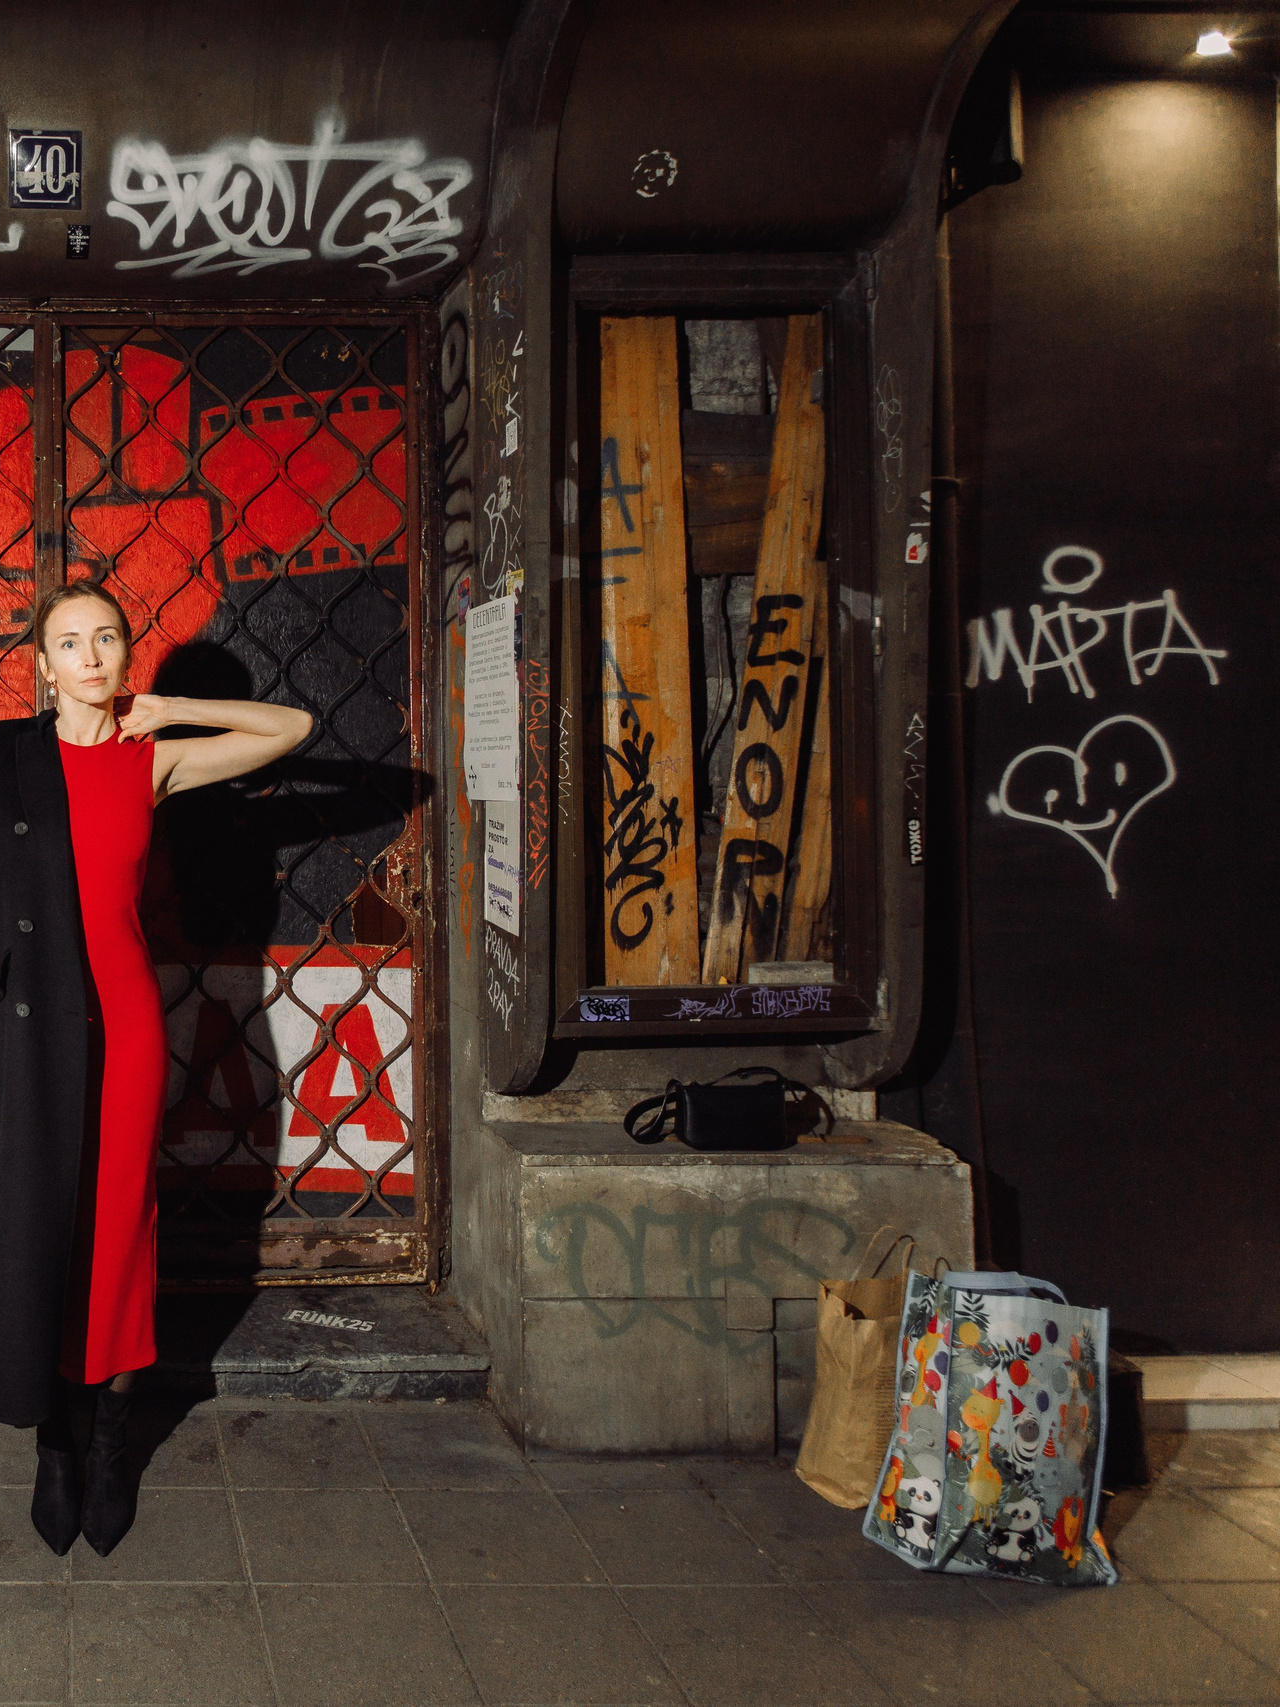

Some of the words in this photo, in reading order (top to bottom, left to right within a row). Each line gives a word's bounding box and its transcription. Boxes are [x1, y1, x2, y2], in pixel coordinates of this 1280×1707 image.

[23, 144, 66, 195] 40
[488, 832, 509, 846] PROSTOR
[488, 844, 495, 854] ZA
